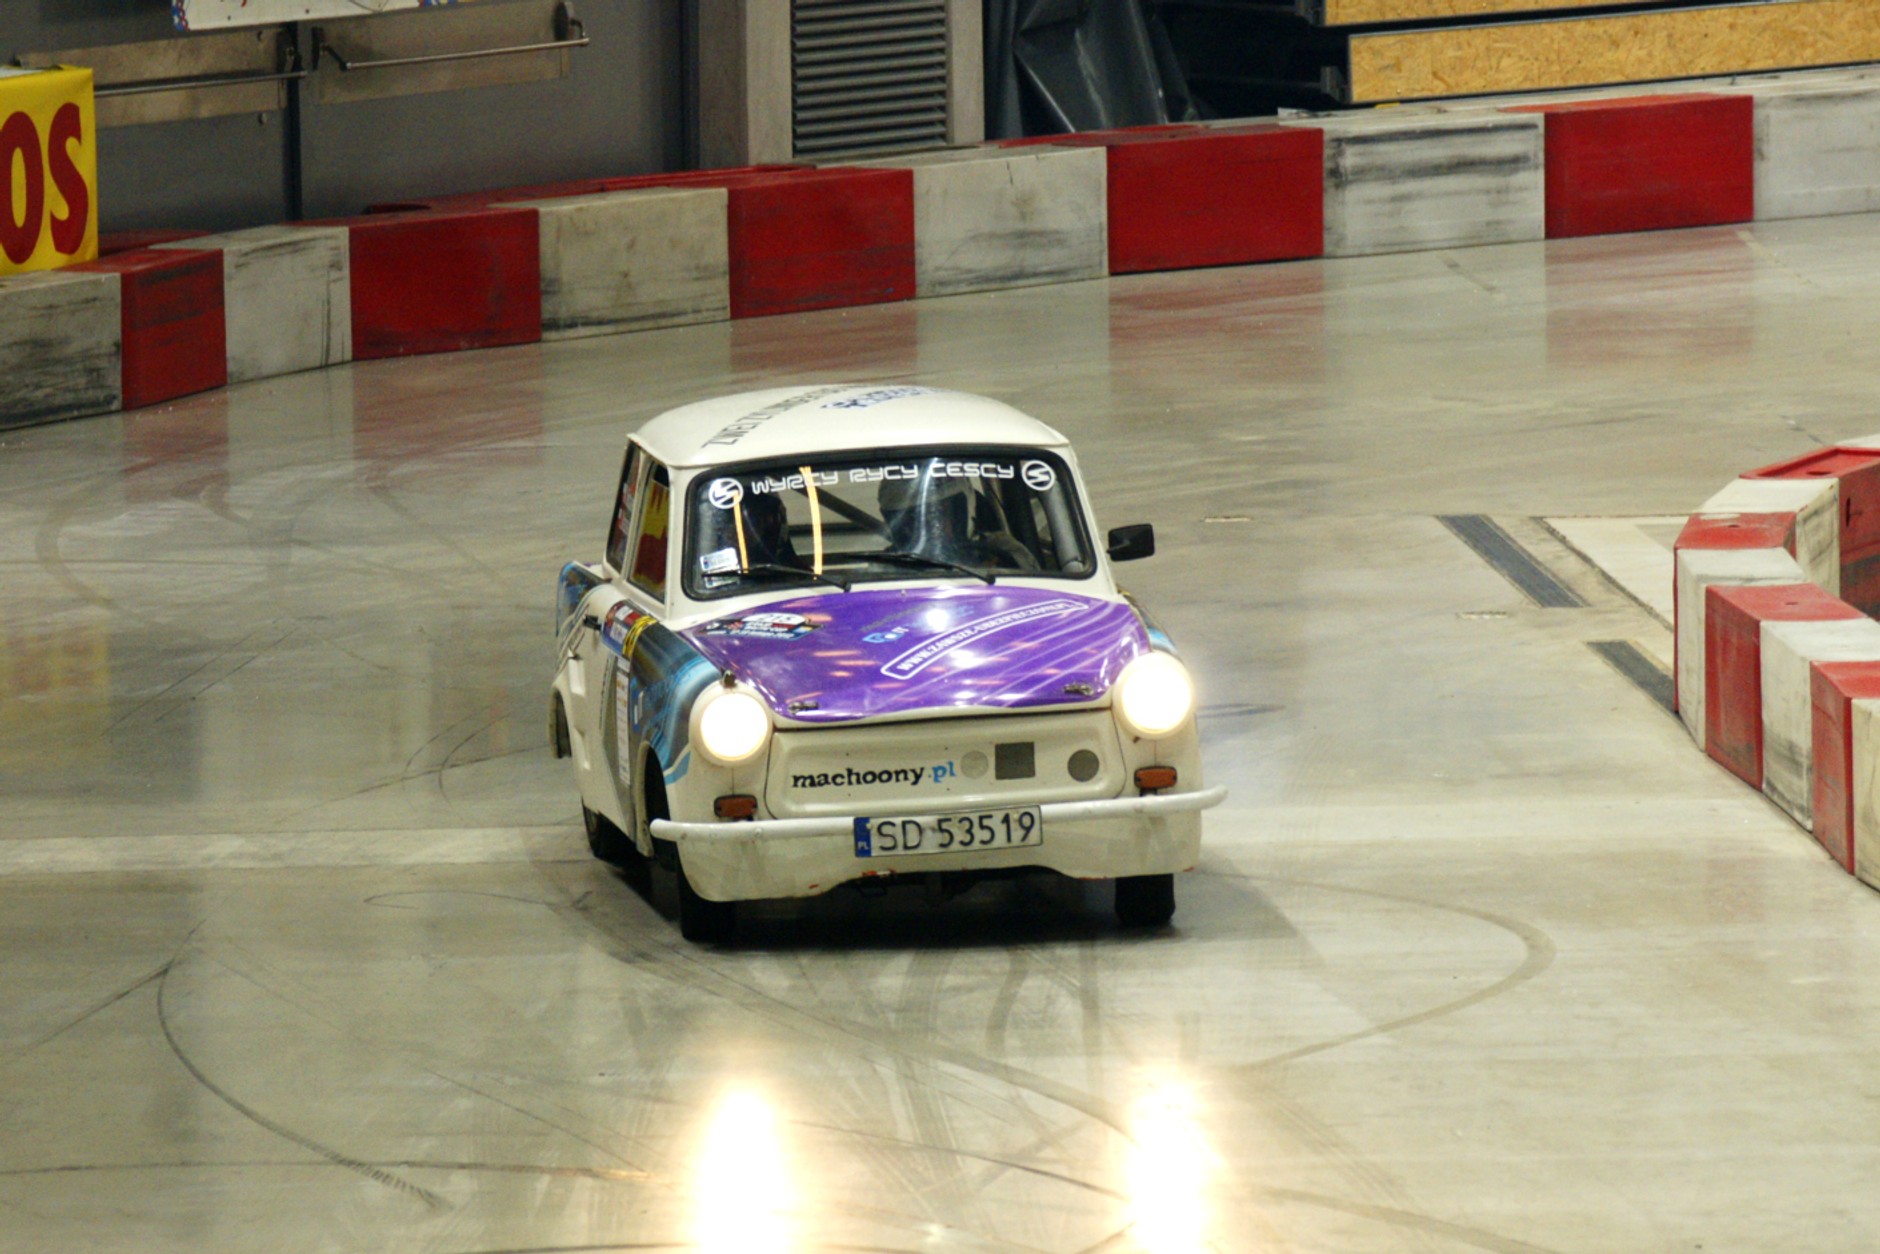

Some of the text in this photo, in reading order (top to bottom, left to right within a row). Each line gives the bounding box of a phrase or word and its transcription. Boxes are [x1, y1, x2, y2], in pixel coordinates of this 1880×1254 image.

[752, 462, 1014, 495] WYRCY RYCY CESCY
[792, 761, 956, 788] machoony.pl
[876, 811, 1035, 851] SD 53519
